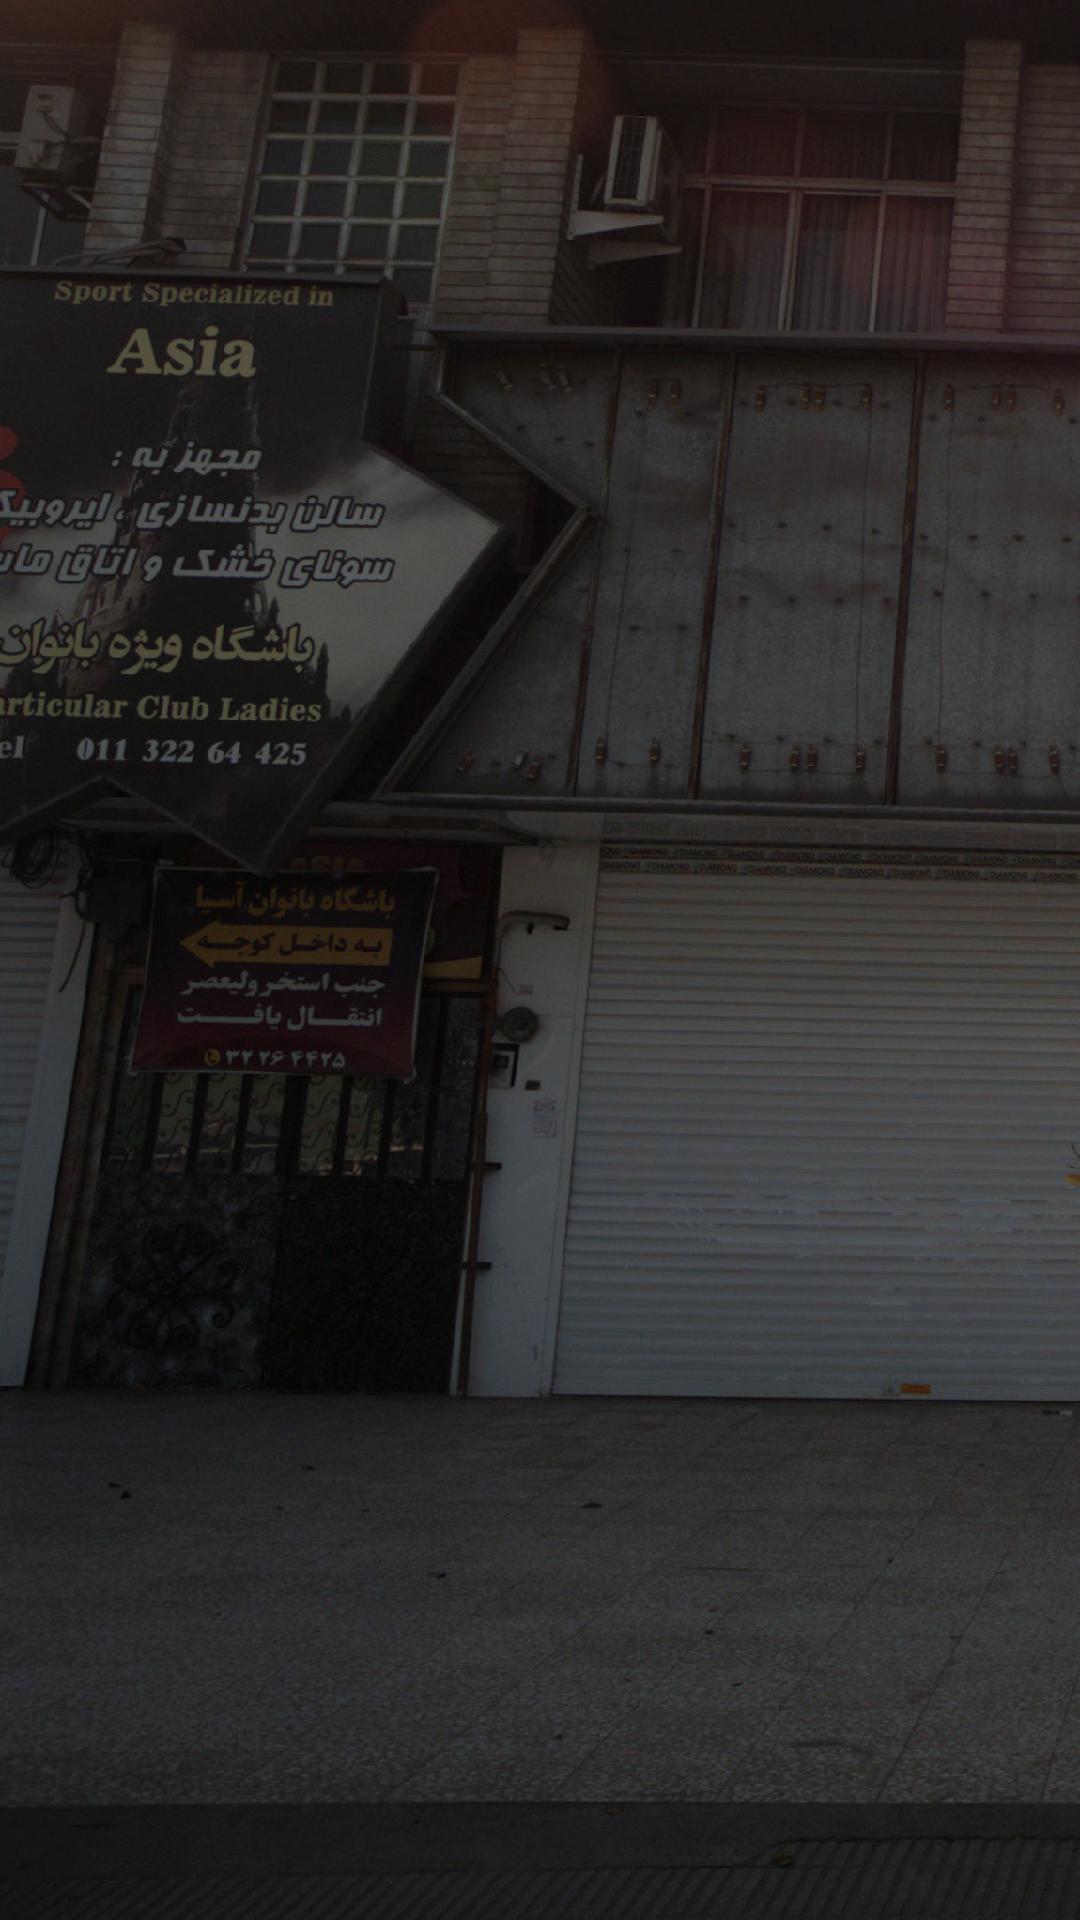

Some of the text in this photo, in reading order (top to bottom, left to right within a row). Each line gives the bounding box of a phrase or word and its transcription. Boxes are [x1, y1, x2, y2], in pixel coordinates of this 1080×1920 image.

[54, 280, 334, 306] Sport Specialized in
[106, 326, 257, 377] Asia
[176, 441, 262, 475] مجهز
[137, 495, 286, 534] بدنسازی
[292, 496, 385, 532] سالن
[56, 544, 137, 583] اتاق
[143, 555, 163, 582] و
[172, 544, 275, 582] خشک
[280, 551, 395, 587] سونای
[0, 617, 314, 674] باشگاه ویژه بانوان
[137, 695, 209, 721] Club
[218, 697, 322, 723] Ladies
[77, 736, 128, 761] 011
[142, 738, 195, 764] 322
[207, 741, 242, 766] 64
[254, 741, 308, 766] 425
[195, 880, 396, 920] باشگاه بانوان آسیا
[197, 932, 383, 959] به داخل کوچه
[258, 971, 331, 997] استخر
[334, 977, 385, 999] جنب
[177, 1003, 383, 1031] انتقال یافت
